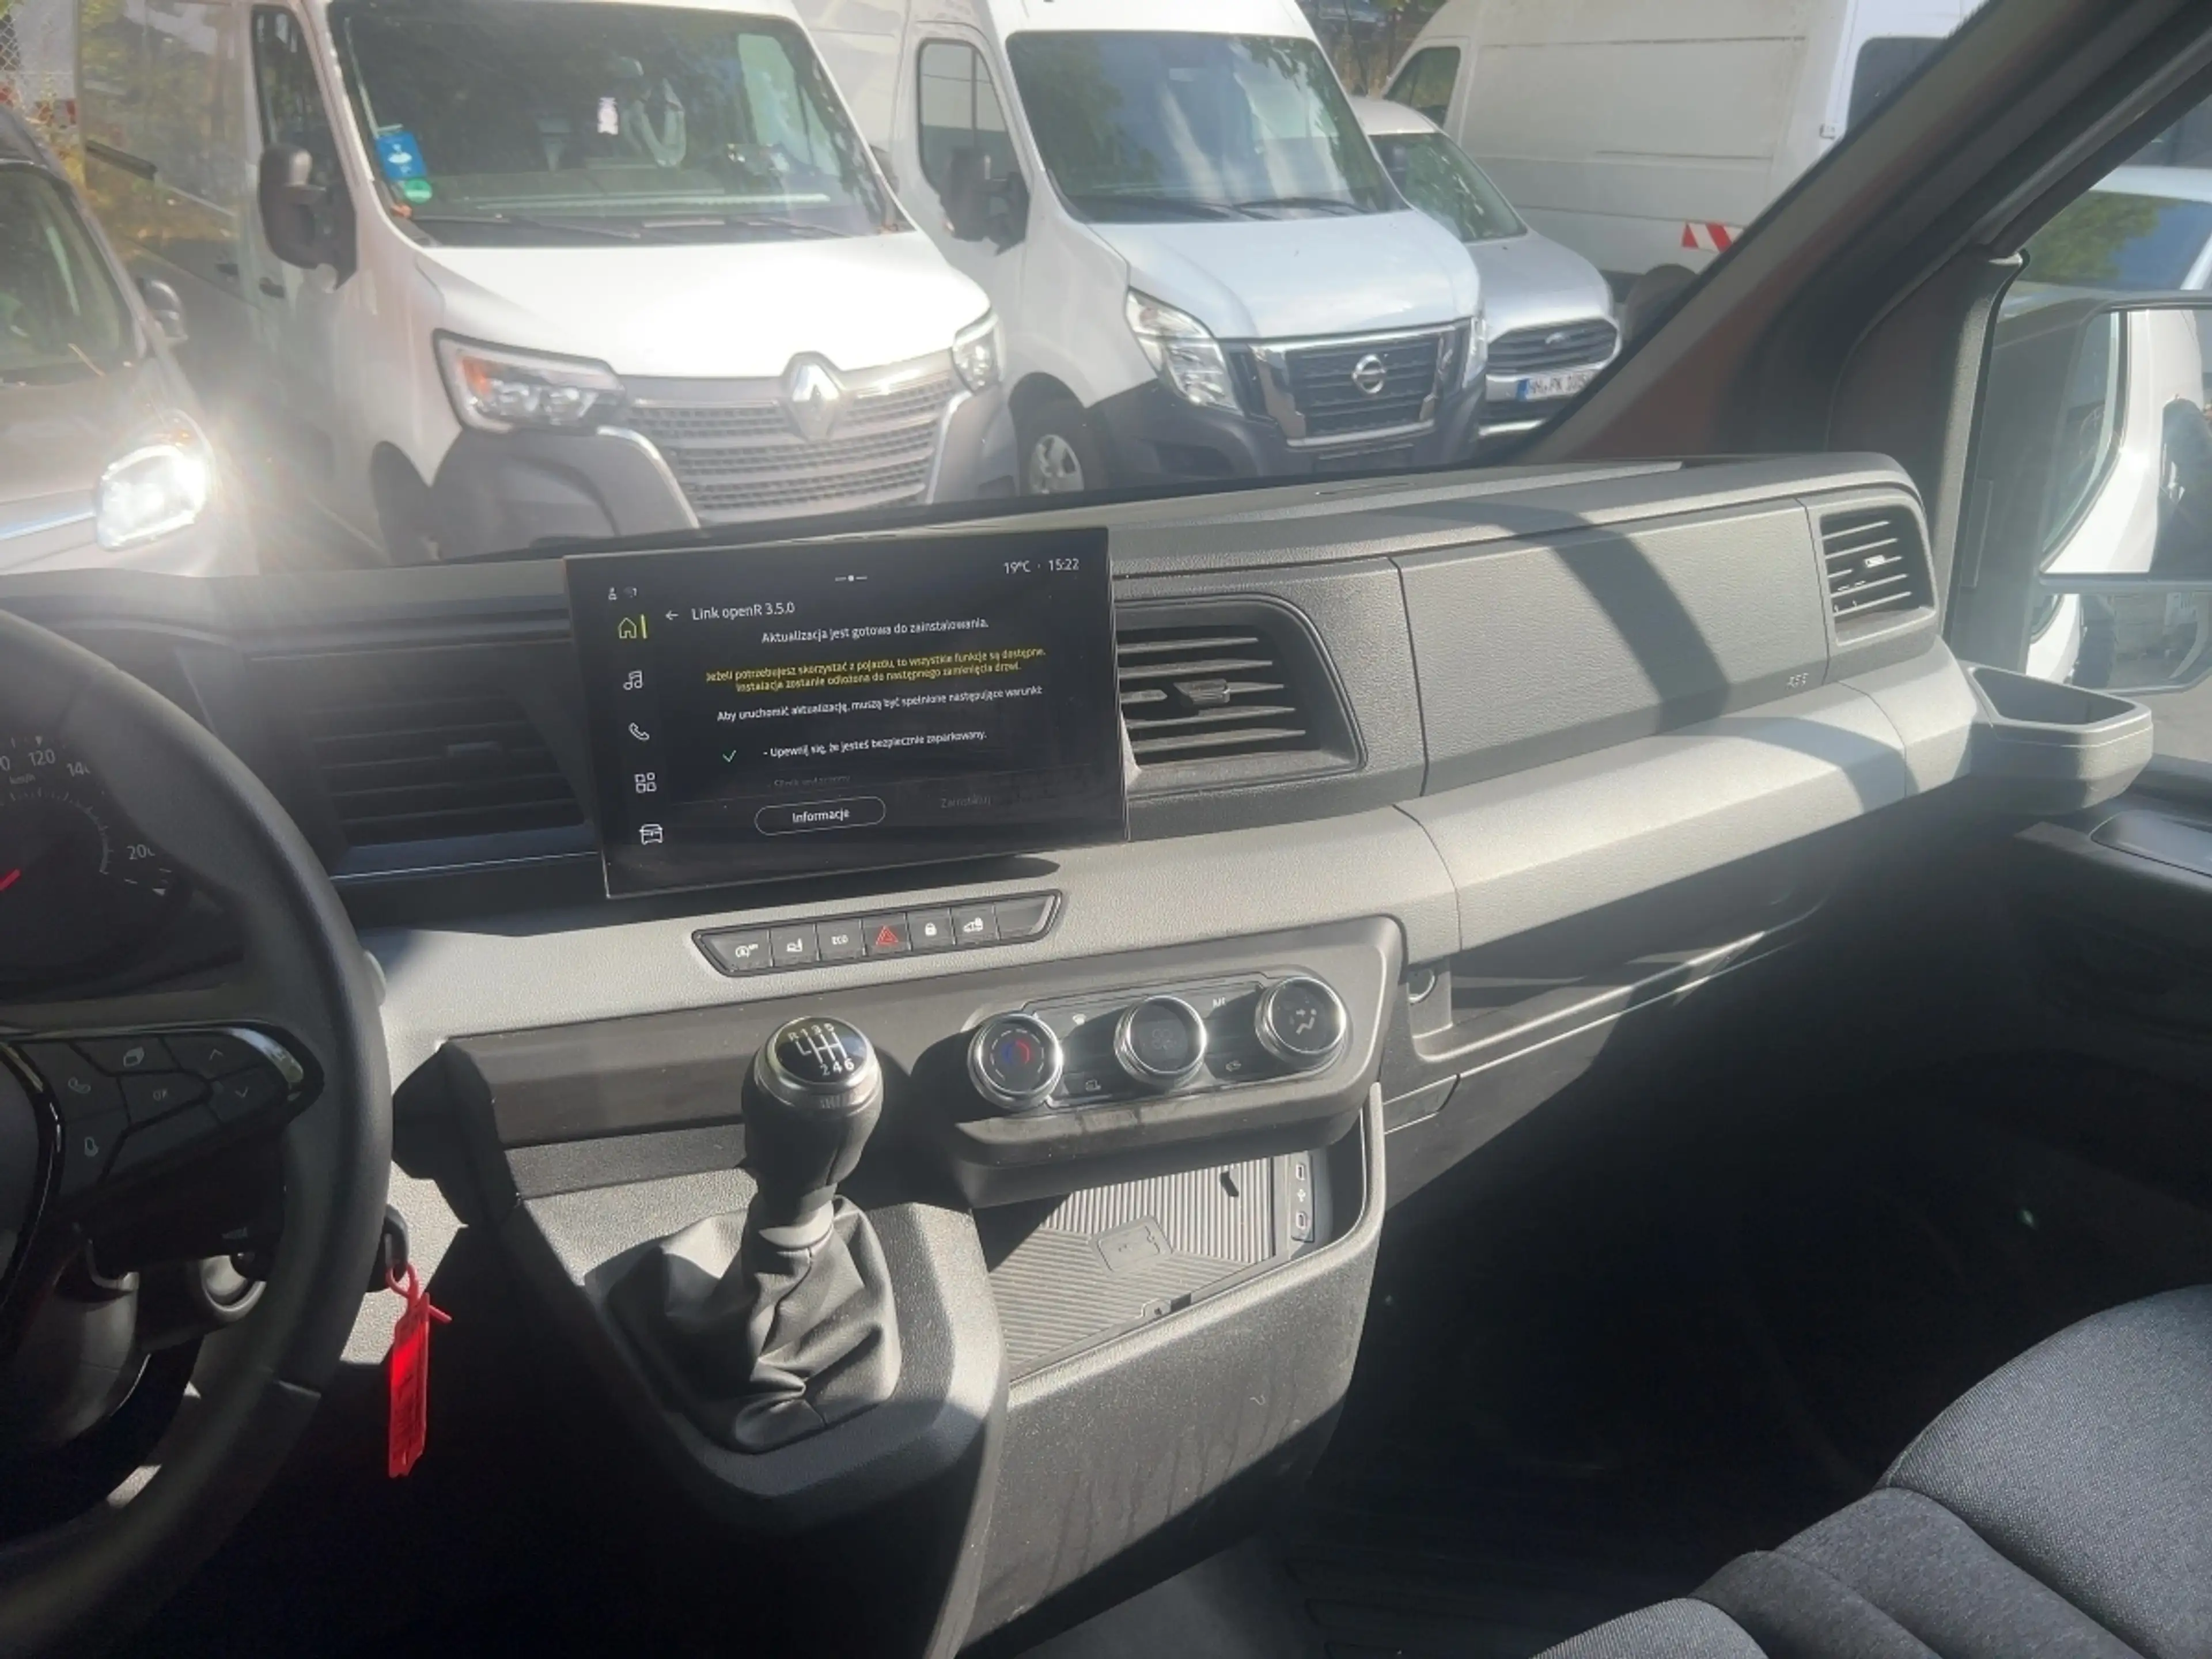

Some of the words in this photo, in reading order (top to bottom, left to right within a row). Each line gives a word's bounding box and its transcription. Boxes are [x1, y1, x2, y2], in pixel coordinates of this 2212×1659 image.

[1003, 560, 1031, 574] 19°C
[1048, 558, 1080, 571] 15:22
[692, 607, 719, 620] Link
[722, 604, 762, 620] openR
[765, 601, 796, 615] 3.5.0
[762, 628, 828, 643] Aktualizacja
[830, 627, 849, 641] jest
[851, 624, 891, 641] gotowa
[894, 623, 908, 634] do
[910, 618, 989, 634] zainstalowania.
[897, 658, 907, 668] to
[908, 654, 952, 669] wszystkie
[955, 651, 987, 664] funkcje
[872, 671, 885, 682] do
[718, 711, 737, 722] Aby
[739, 705, 790, 719] uruchomić
[770, 744, 808, 759] Upewnij
[840, 738, 870, 753] jesteś
[872, 736, 925, 749] bezpiecznie
[29, 749, 55, 767] 120
[792, 808, 851, 824] Informacje
[820, 1063, 831, 1076] 2
[833, 1060, 843, 1074] 4
[844, 1058, 854, 1071] 6
